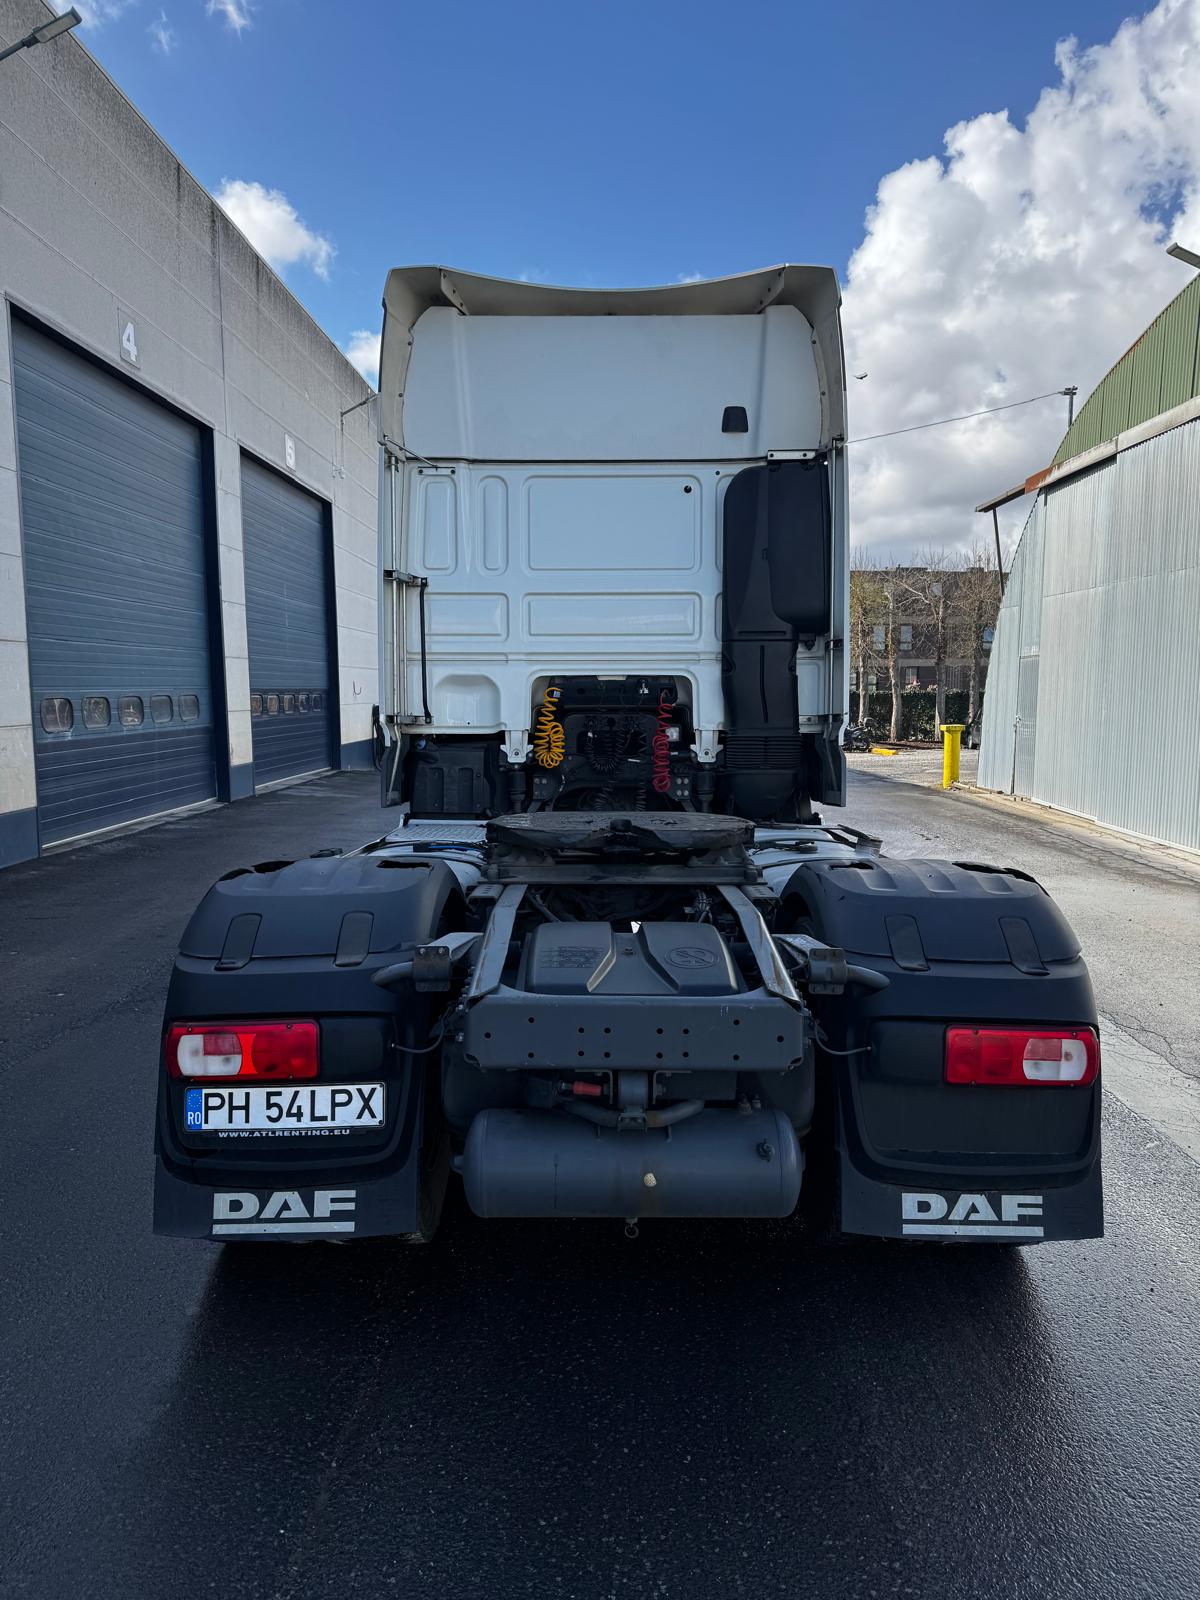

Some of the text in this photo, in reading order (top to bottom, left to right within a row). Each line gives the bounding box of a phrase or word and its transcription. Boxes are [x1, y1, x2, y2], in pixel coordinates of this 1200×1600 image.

[122, 322, 137, 362] 4
[287, 438, 295, 466] 5
[188, 1112, 201, 1125] RO
[204, 1092, 250, 1124] PH
[218, 1129, 350, 1138] WWW.ATLRENTING.EU
[213, 1190, 356, 1219] DAF
[902, 1193, 1042, 1221] DAF
